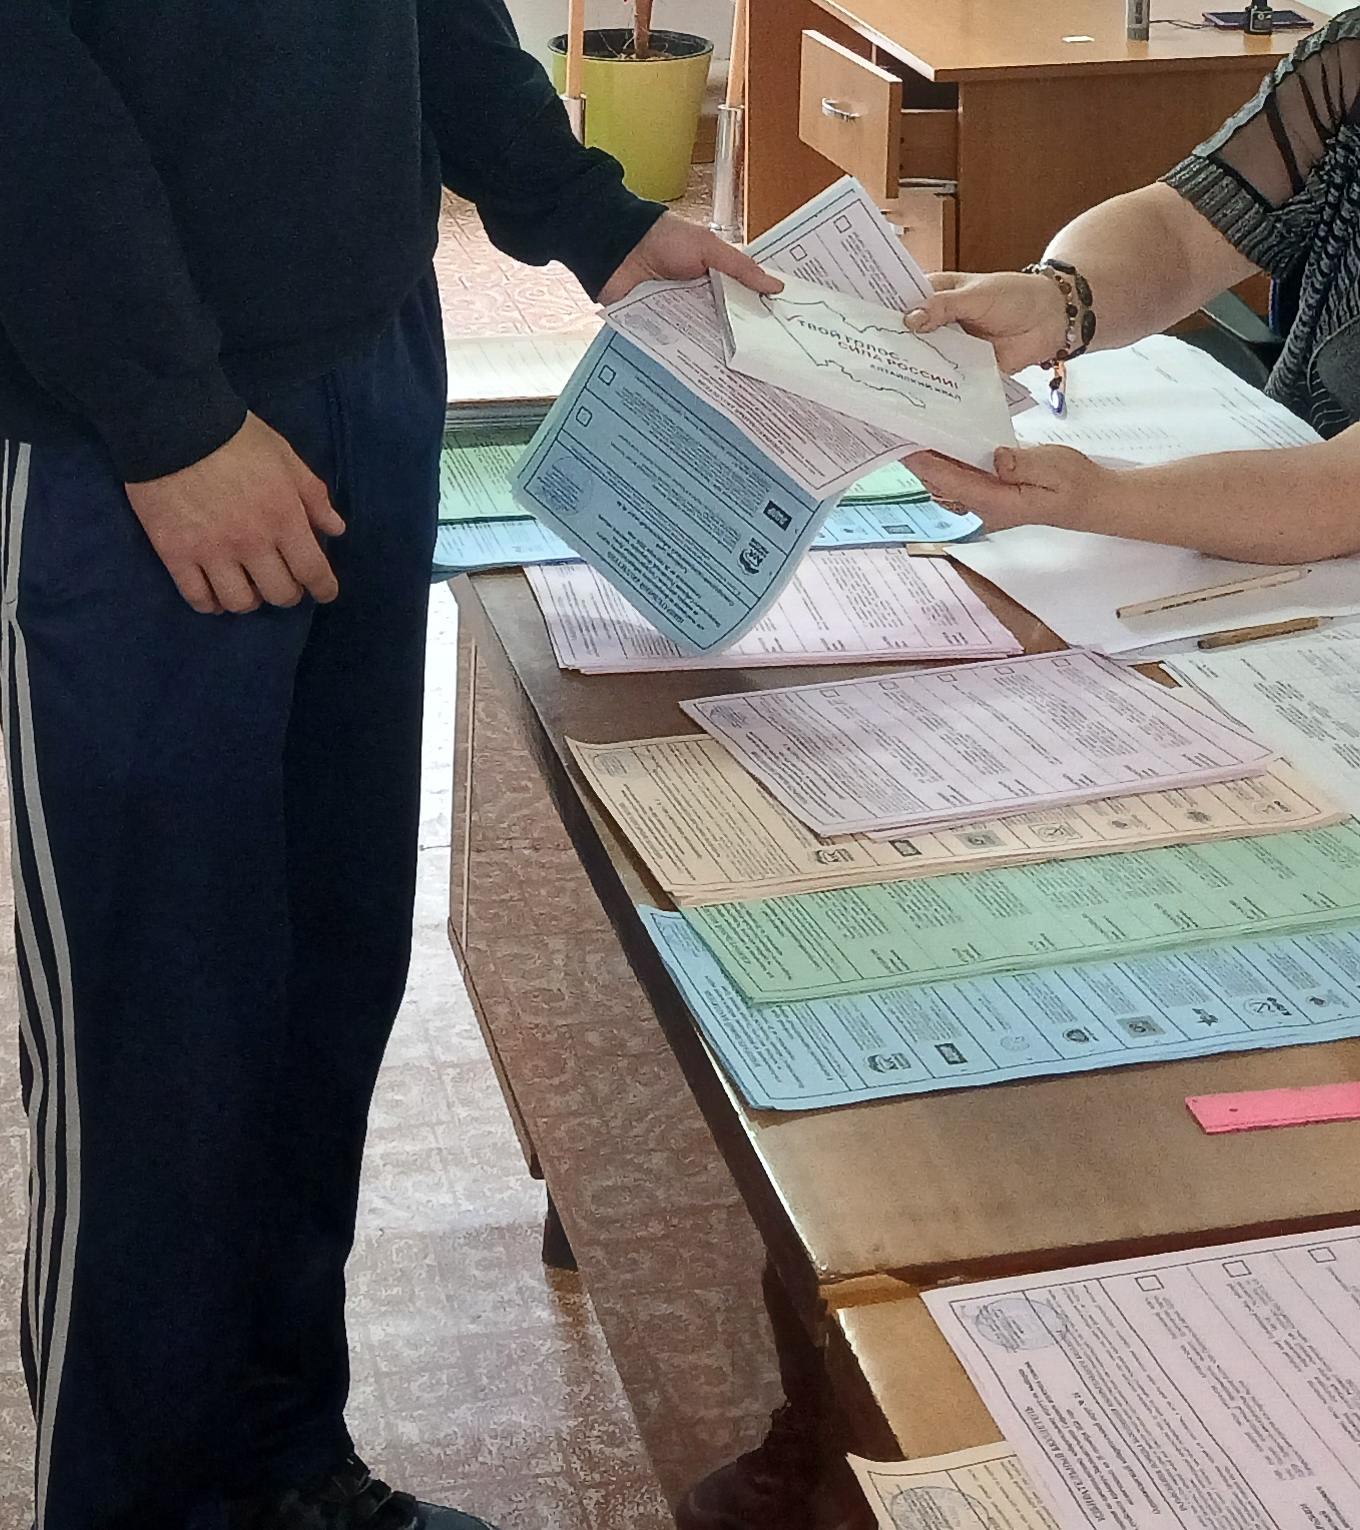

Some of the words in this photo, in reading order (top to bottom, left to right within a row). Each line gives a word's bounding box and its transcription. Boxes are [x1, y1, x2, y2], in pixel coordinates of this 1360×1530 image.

[796, 319, 842, 340] ТВОЙ
[844, 333, 902, 361] ГОЛОС
[837, 341, 884, 364] СИЛА
